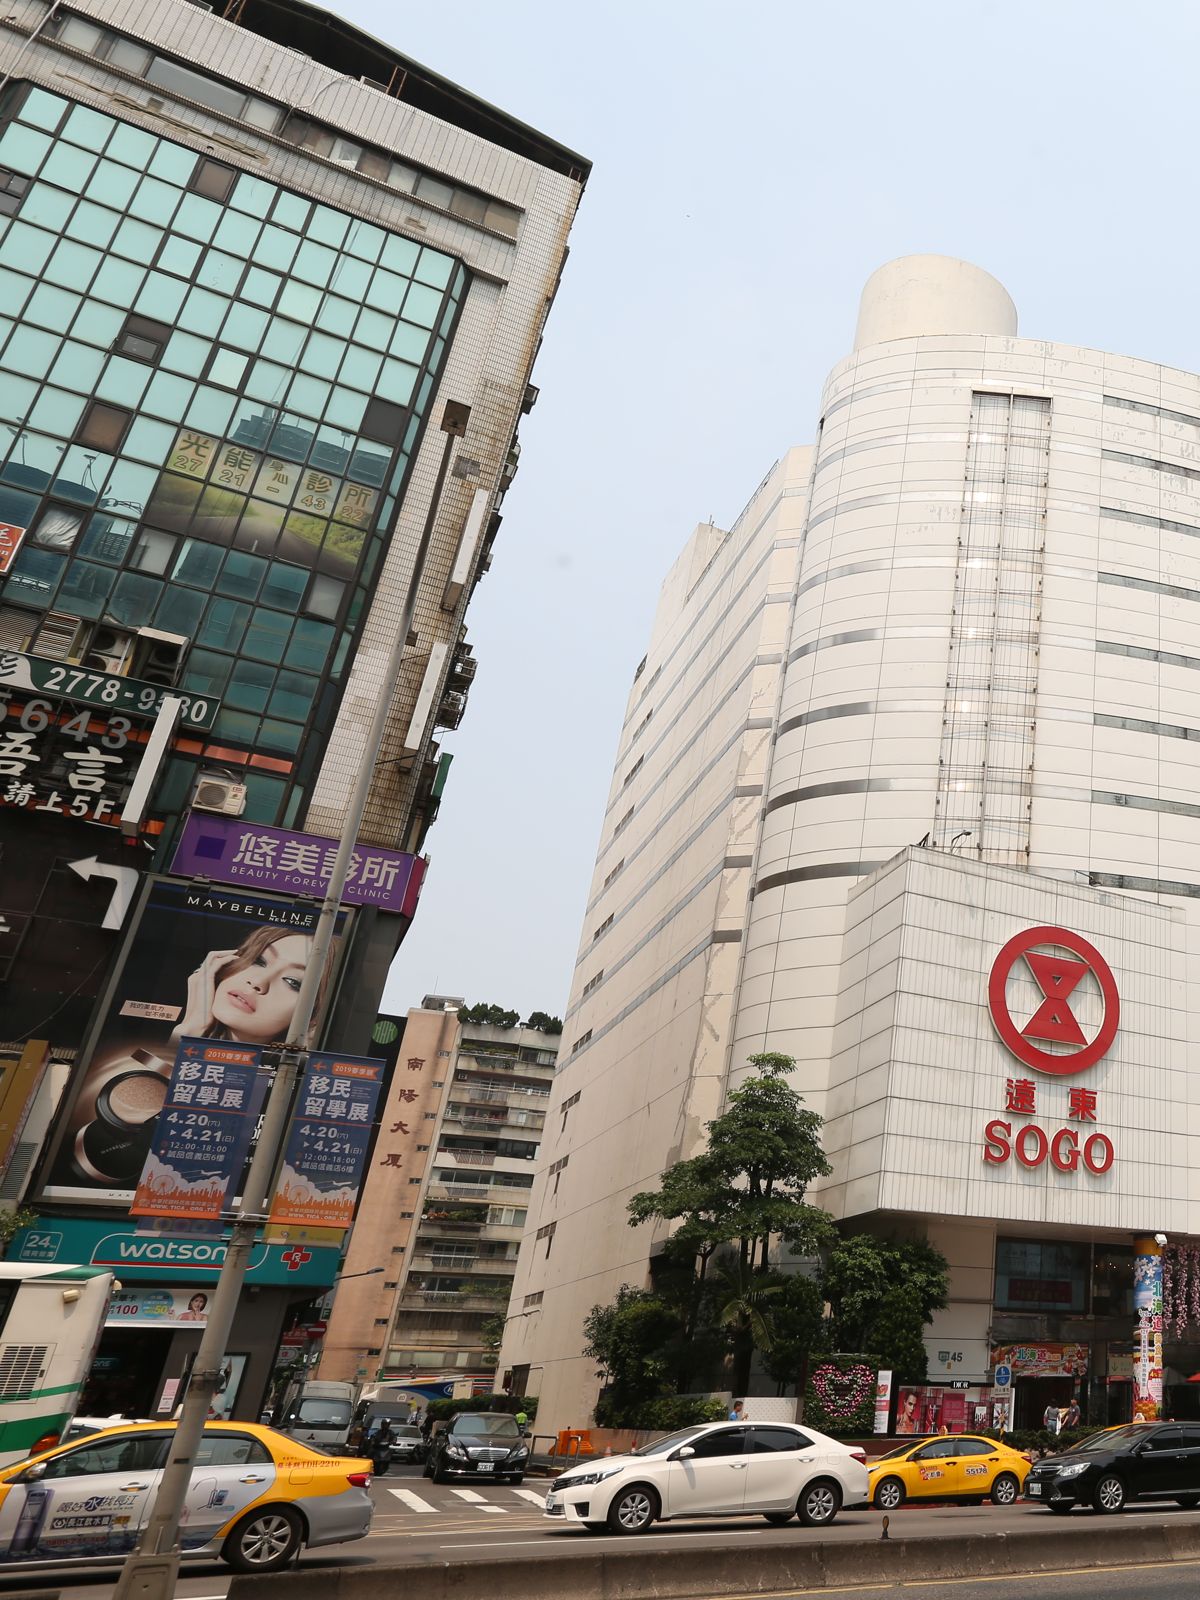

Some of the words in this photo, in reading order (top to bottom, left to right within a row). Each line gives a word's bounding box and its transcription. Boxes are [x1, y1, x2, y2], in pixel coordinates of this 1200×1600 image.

[231, 865, 278, 880] BEAUTY
[284, 874, 332, 888] FOREV
[347, 886, 391, 900] CLINIC
[187, 895, 314, 924] MAYBELLINE
[178, 1061, 225, 1084] 移民
[172, 1083, 244, 1109] 留學展
[308, 1075, 351, 1098] 移民
[304, 1096, 369, 1122] 留學展
[1005, 1078, 1098, 1121] 遠東
[982, 1119, 1115, 1176] SOGO
[26, 1234, 49, 1249] 24
[120, 1240, 229, 1262] watson
[116, 1304, 139, 1315] 100
[950, 1352, 963, 1363] 45
[965, 1467, 988, 1475] 55178
